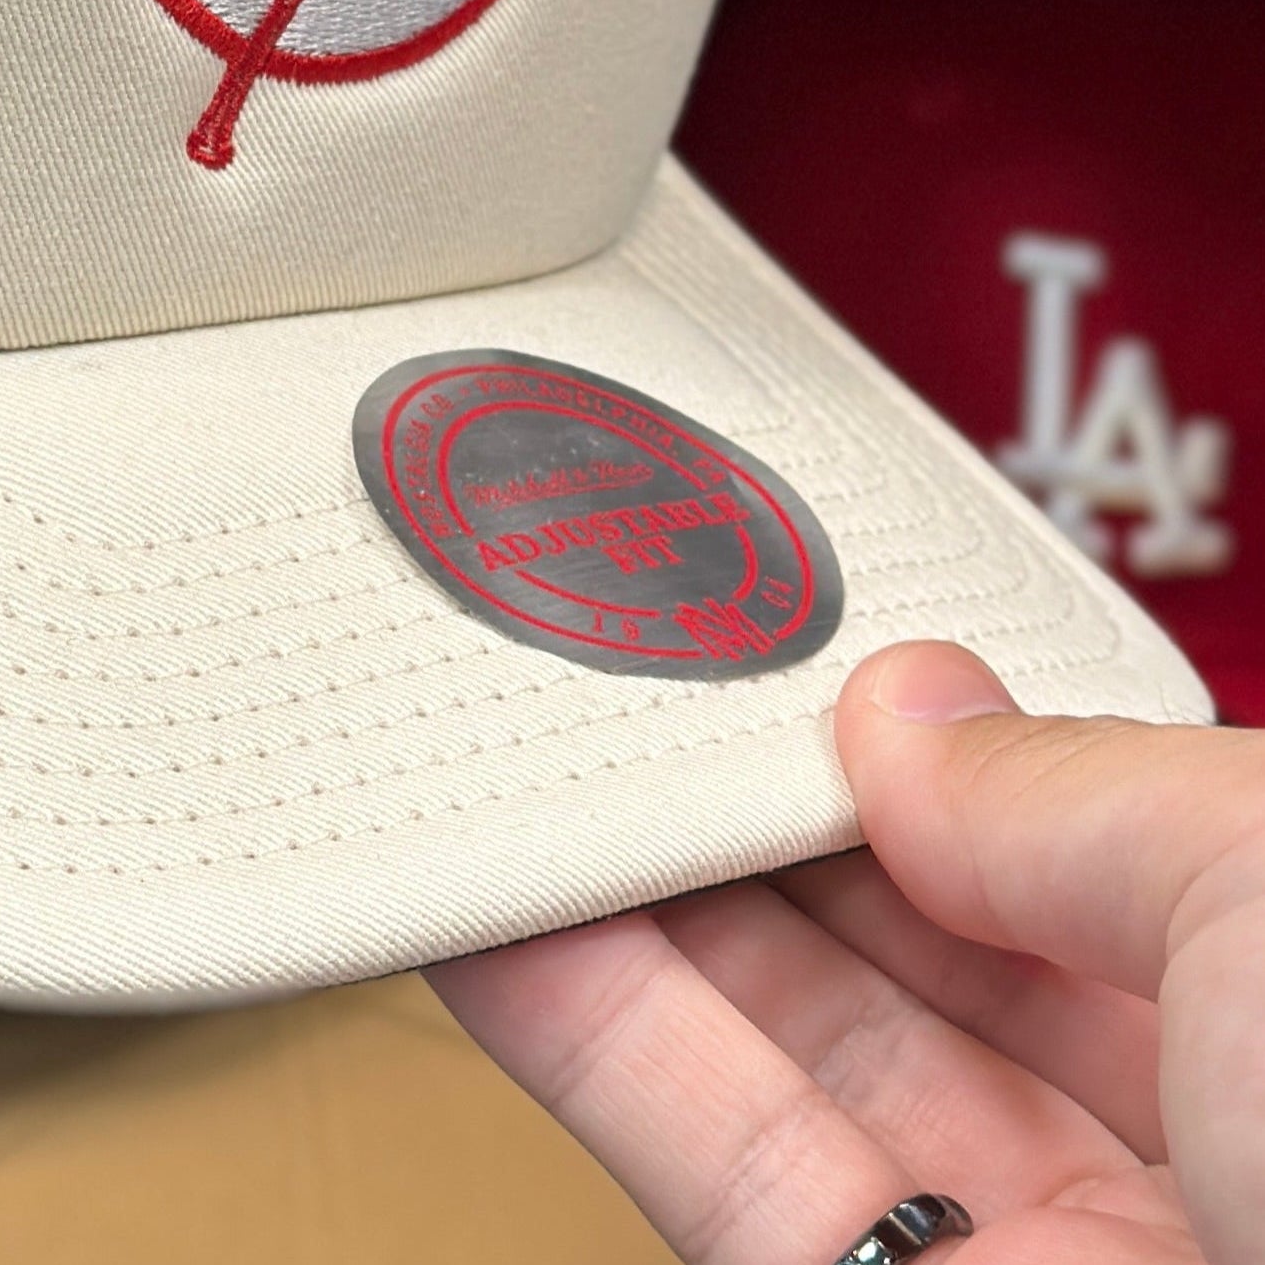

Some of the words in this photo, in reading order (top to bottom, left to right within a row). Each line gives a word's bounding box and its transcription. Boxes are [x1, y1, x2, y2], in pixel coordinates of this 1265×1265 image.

[1002, 232, 1233, 576] LA
[476, 491, 751, 573] ADJUSTABLE
[601, 535, 684, 575] FIT
